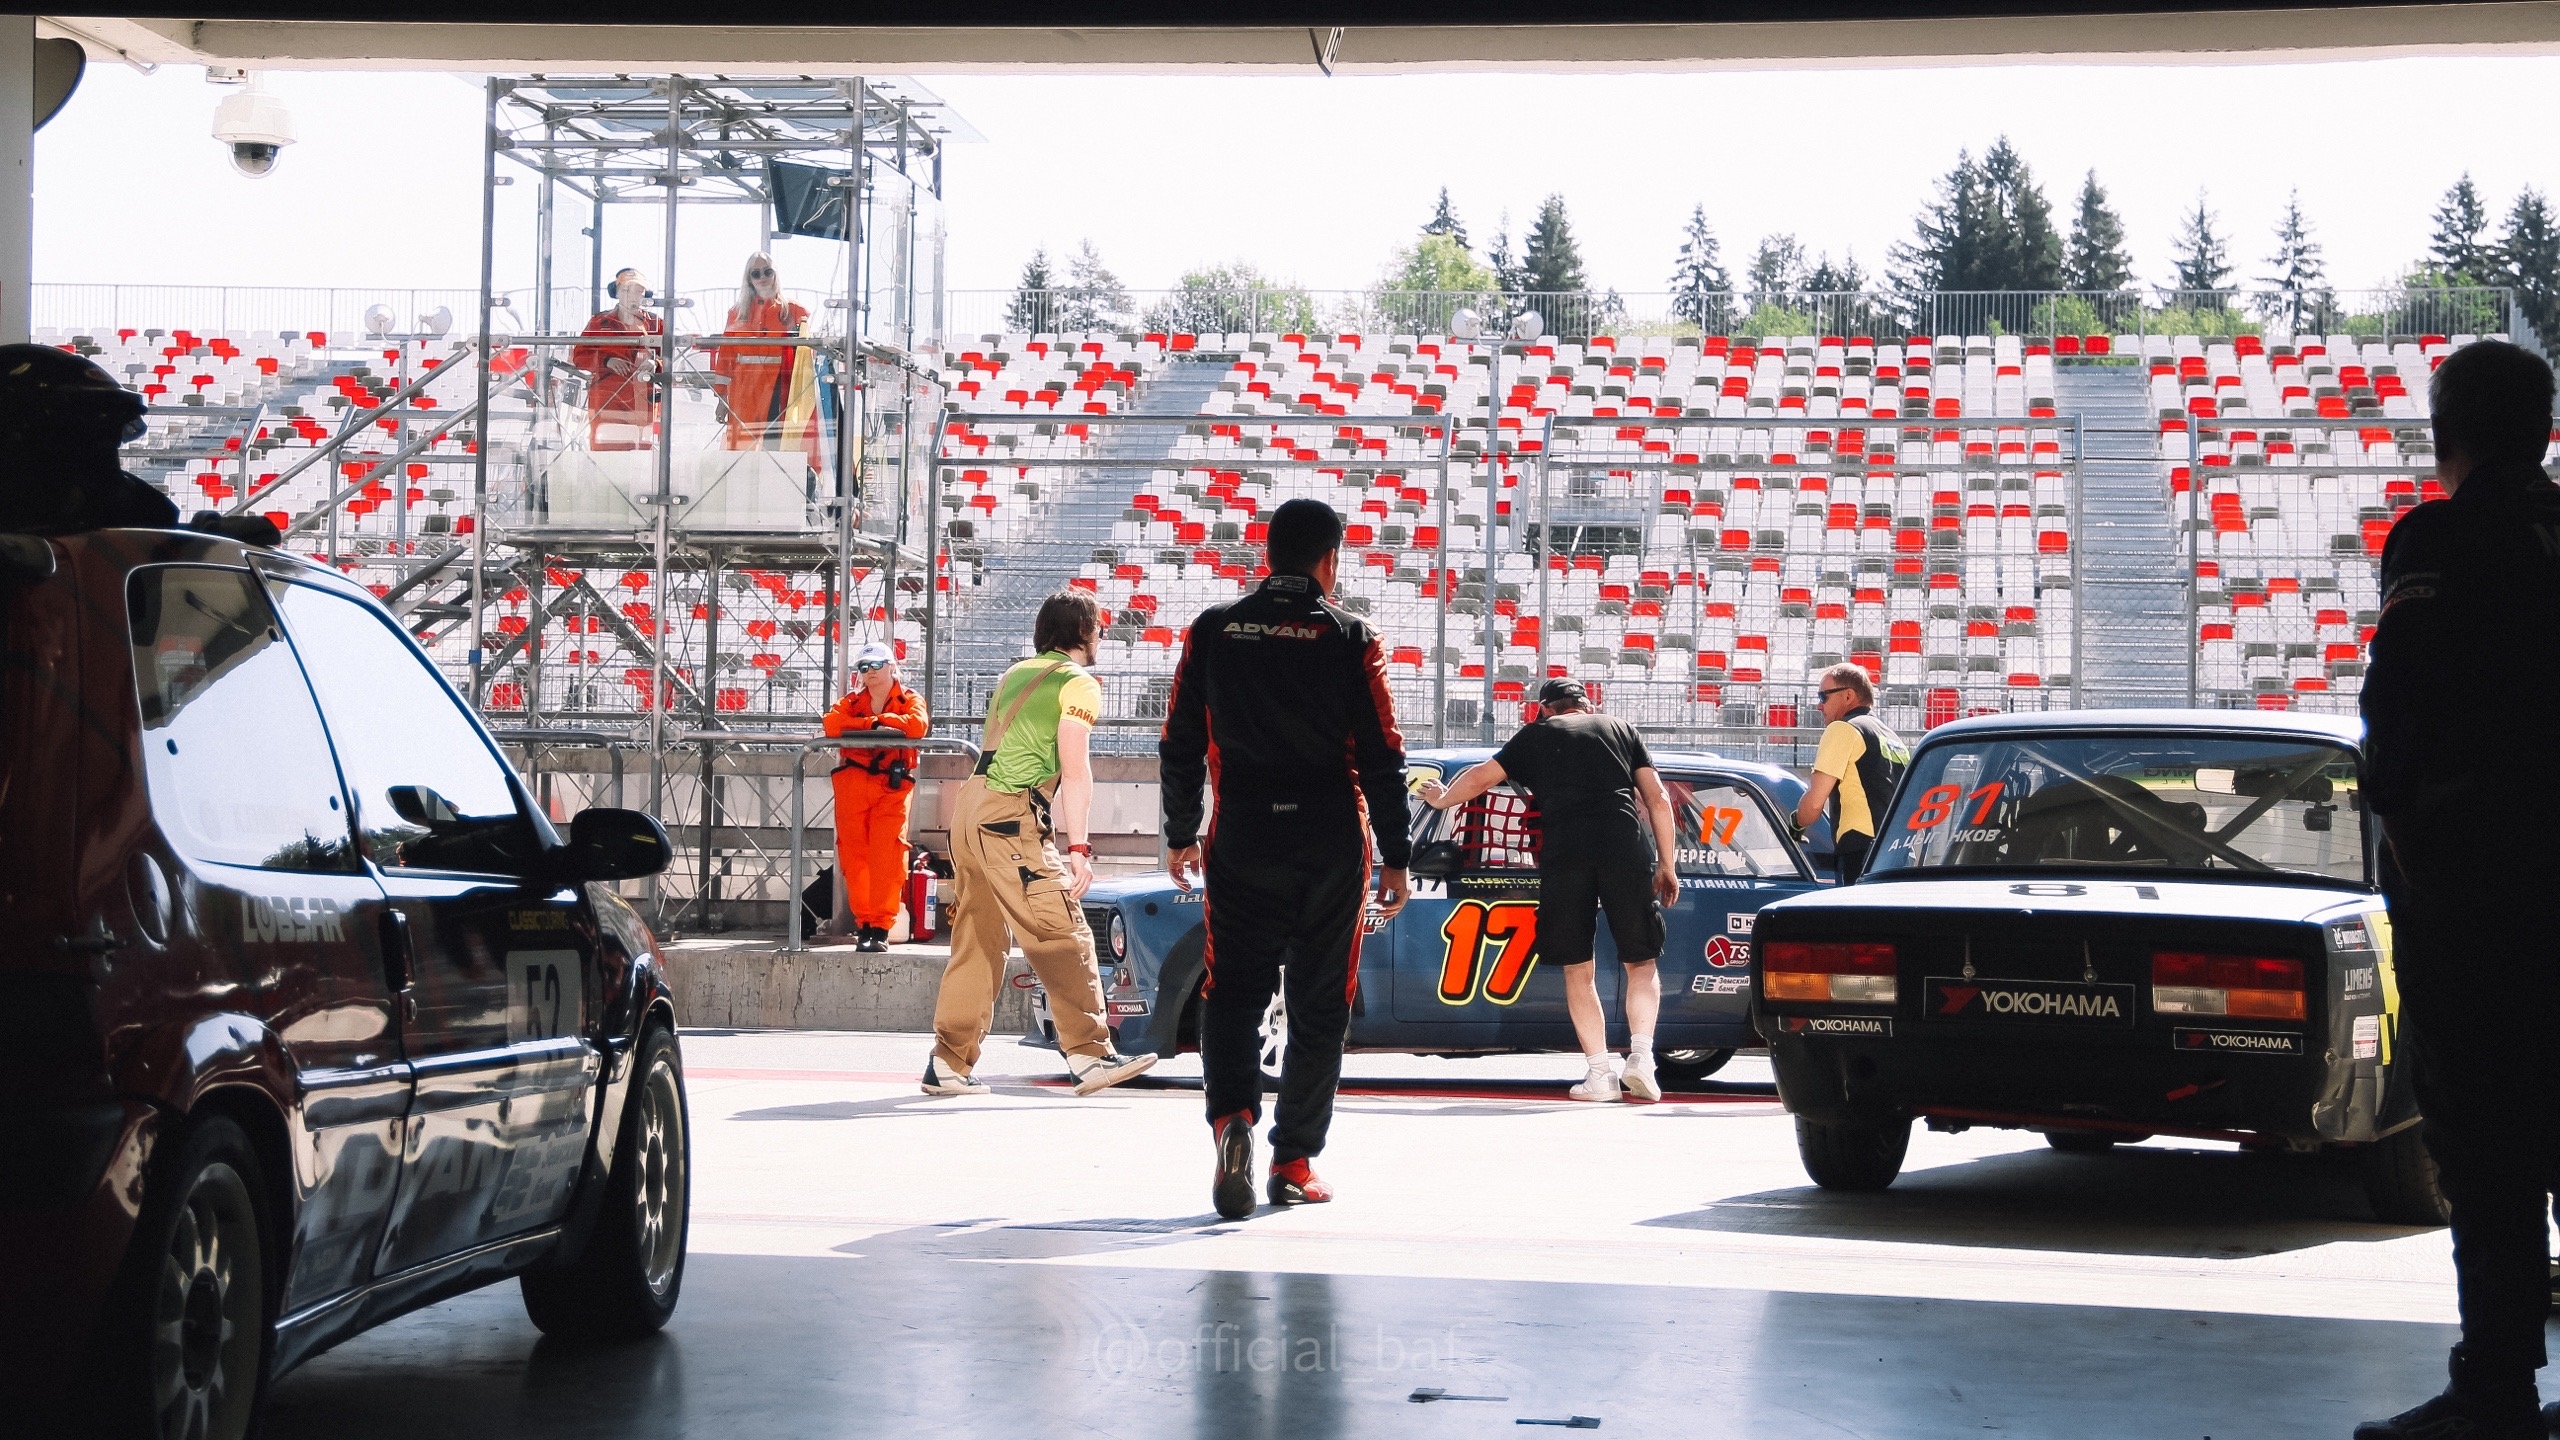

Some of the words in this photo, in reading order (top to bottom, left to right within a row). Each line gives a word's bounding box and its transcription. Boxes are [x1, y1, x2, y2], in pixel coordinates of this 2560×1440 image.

[1223, 622, 1317, 639] ADVAN
[1231, 633, 1261, 641] YOKOHAMA
[1906, 781, 2006, 830] 81
[1699, 804, 1744, 845] 17
[1889, 829, 2001, 850] А.ЦЫГНКОВ
[1410, 875, 1442, 892] 17
[1438, 900, 1539, 1005] 17
[1729, 945, 1750, 959] TS
[1718, 976, 1749, 985] Земский
[1117, 1004, 1144, 1013] YOKOHAMA
[1981, 990, 2120, 1017] YOKOHAMA
[1809, 1019, 1883, 1033] YOKOHAMA
[2210, 1034, 2293, 1050] YOKOHAMA
